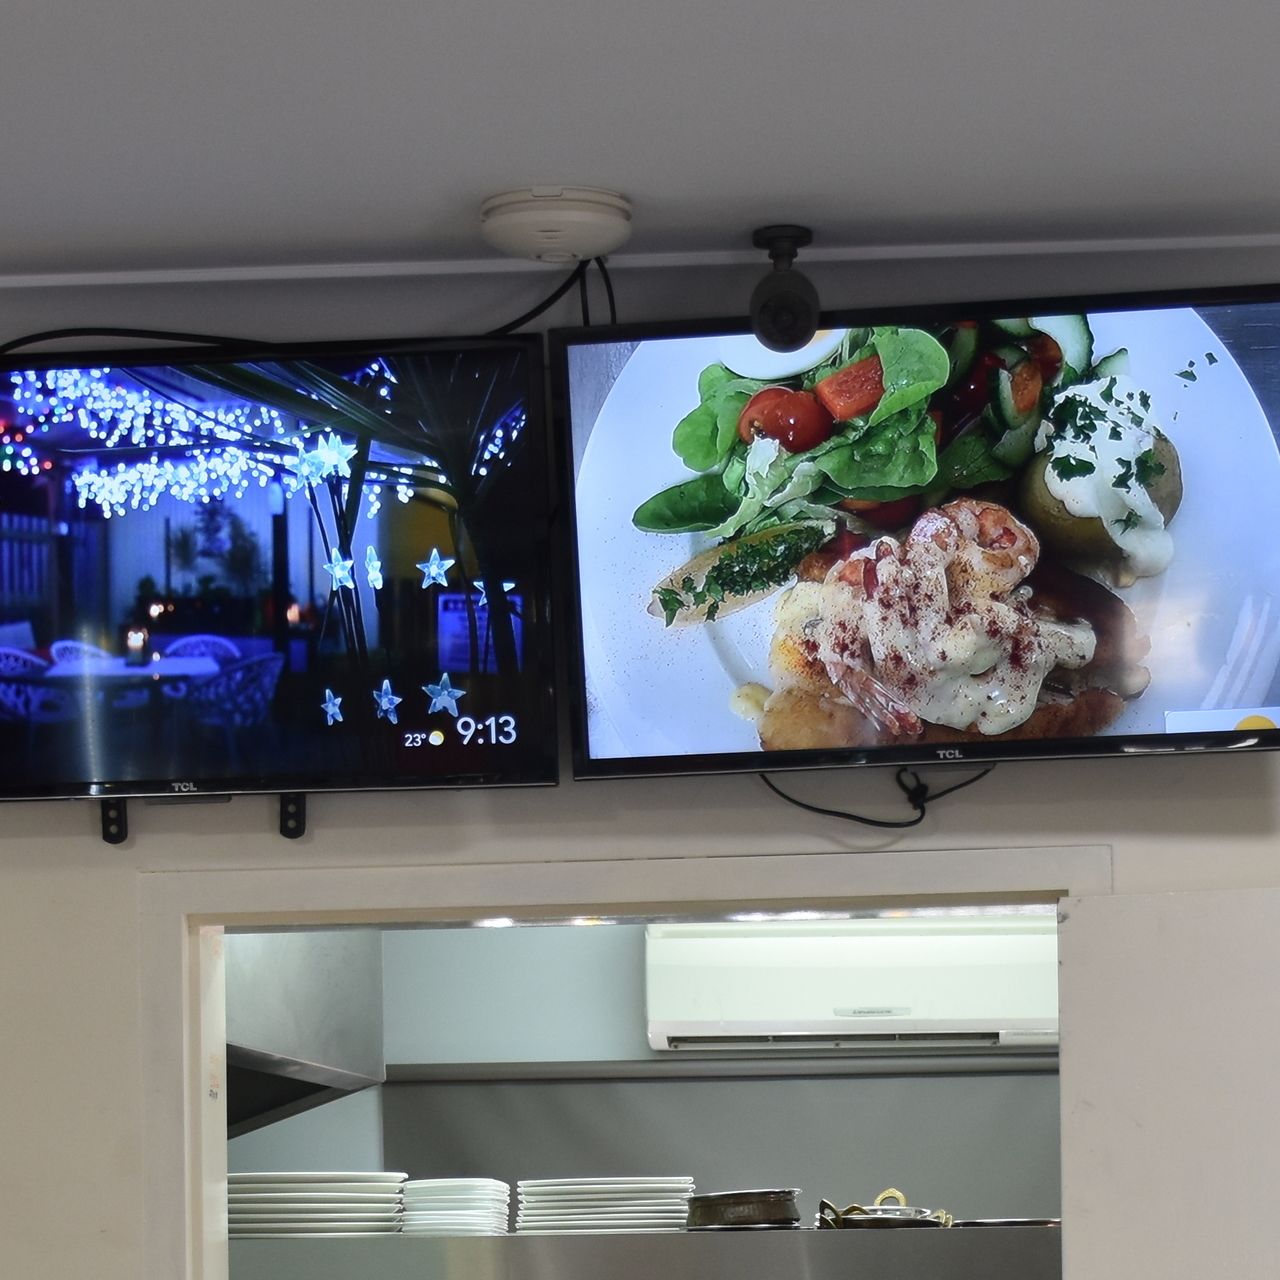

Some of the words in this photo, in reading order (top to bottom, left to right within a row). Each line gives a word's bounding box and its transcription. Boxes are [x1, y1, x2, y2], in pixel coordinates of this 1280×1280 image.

[456, 715, 517, 745] 9:13
[936, 750, 963, 759] TCL
[171, 782, 198, 791] TCL
